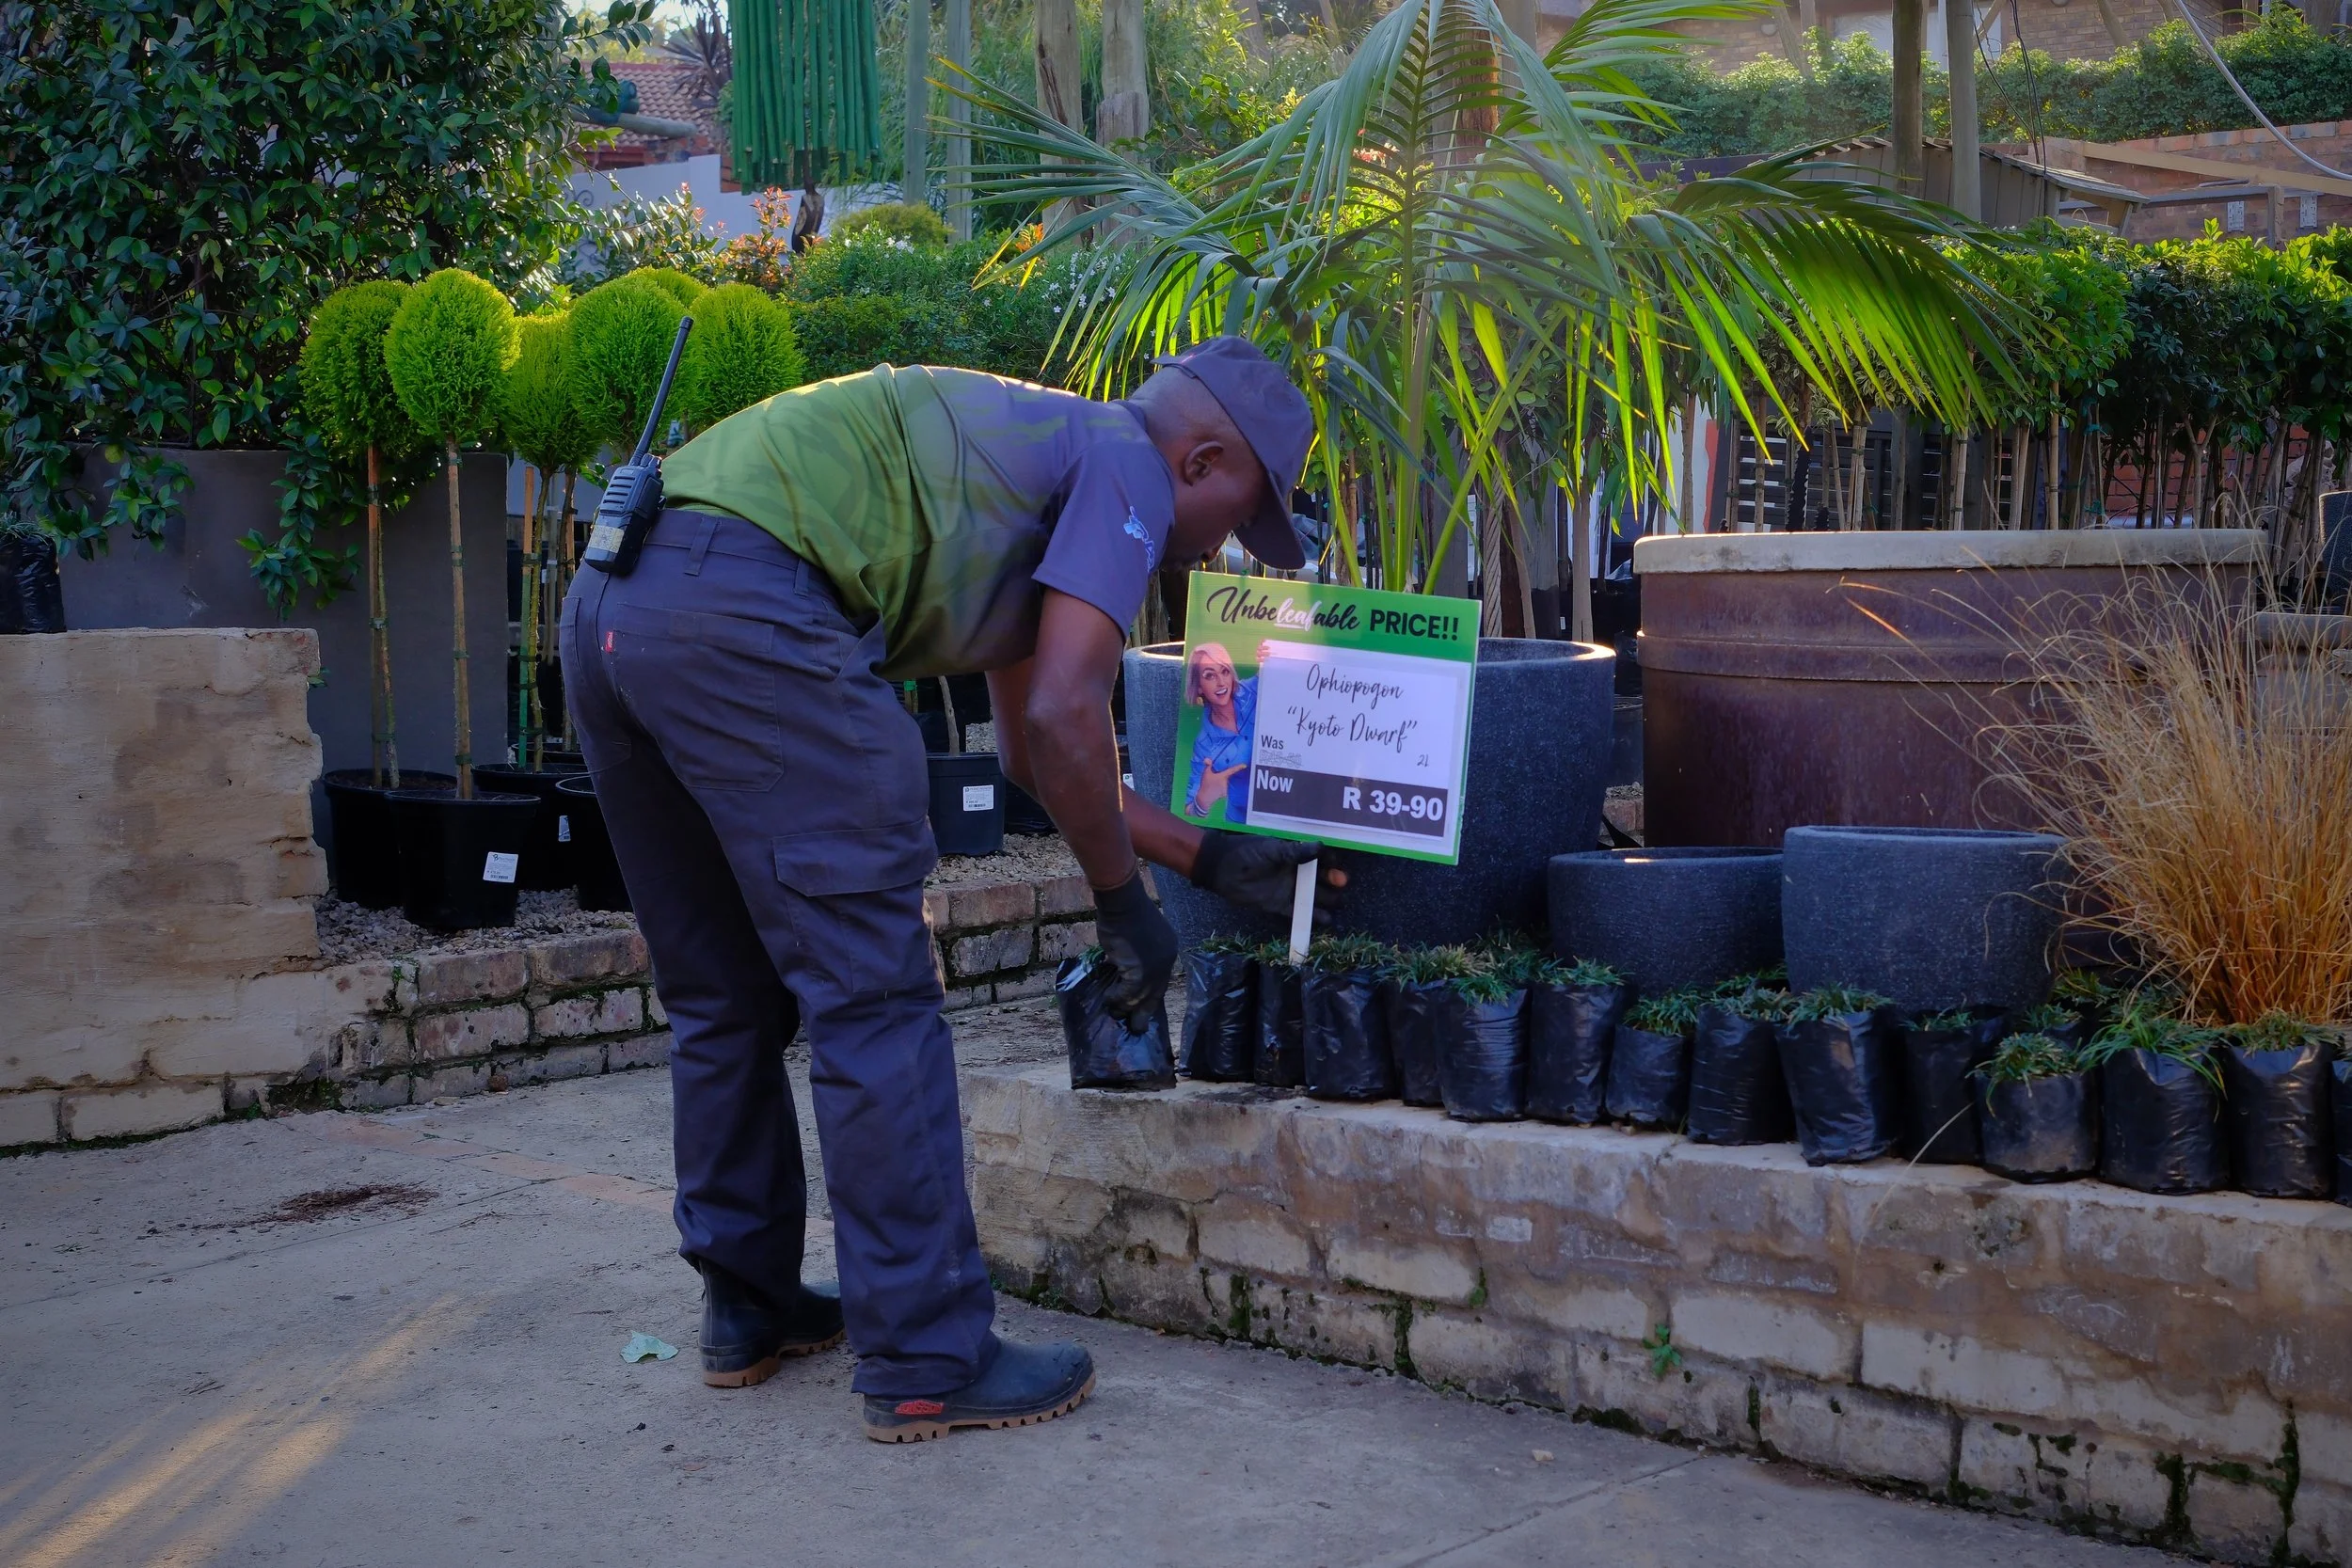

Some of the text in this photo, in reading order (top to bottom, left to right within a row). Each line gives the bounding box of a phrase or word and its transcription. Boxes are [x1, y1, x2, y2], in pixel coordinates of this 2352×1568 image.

[1206, 586, 1459, 641] Unbeleafable PRICE!!
[1306, 663, 1405, 710] Ophiopogon
[1261, 734, 1284, 751] Was
[1256, 768, 1294, 793] Now
[1342, 785, 1444, 822] R 39-90
